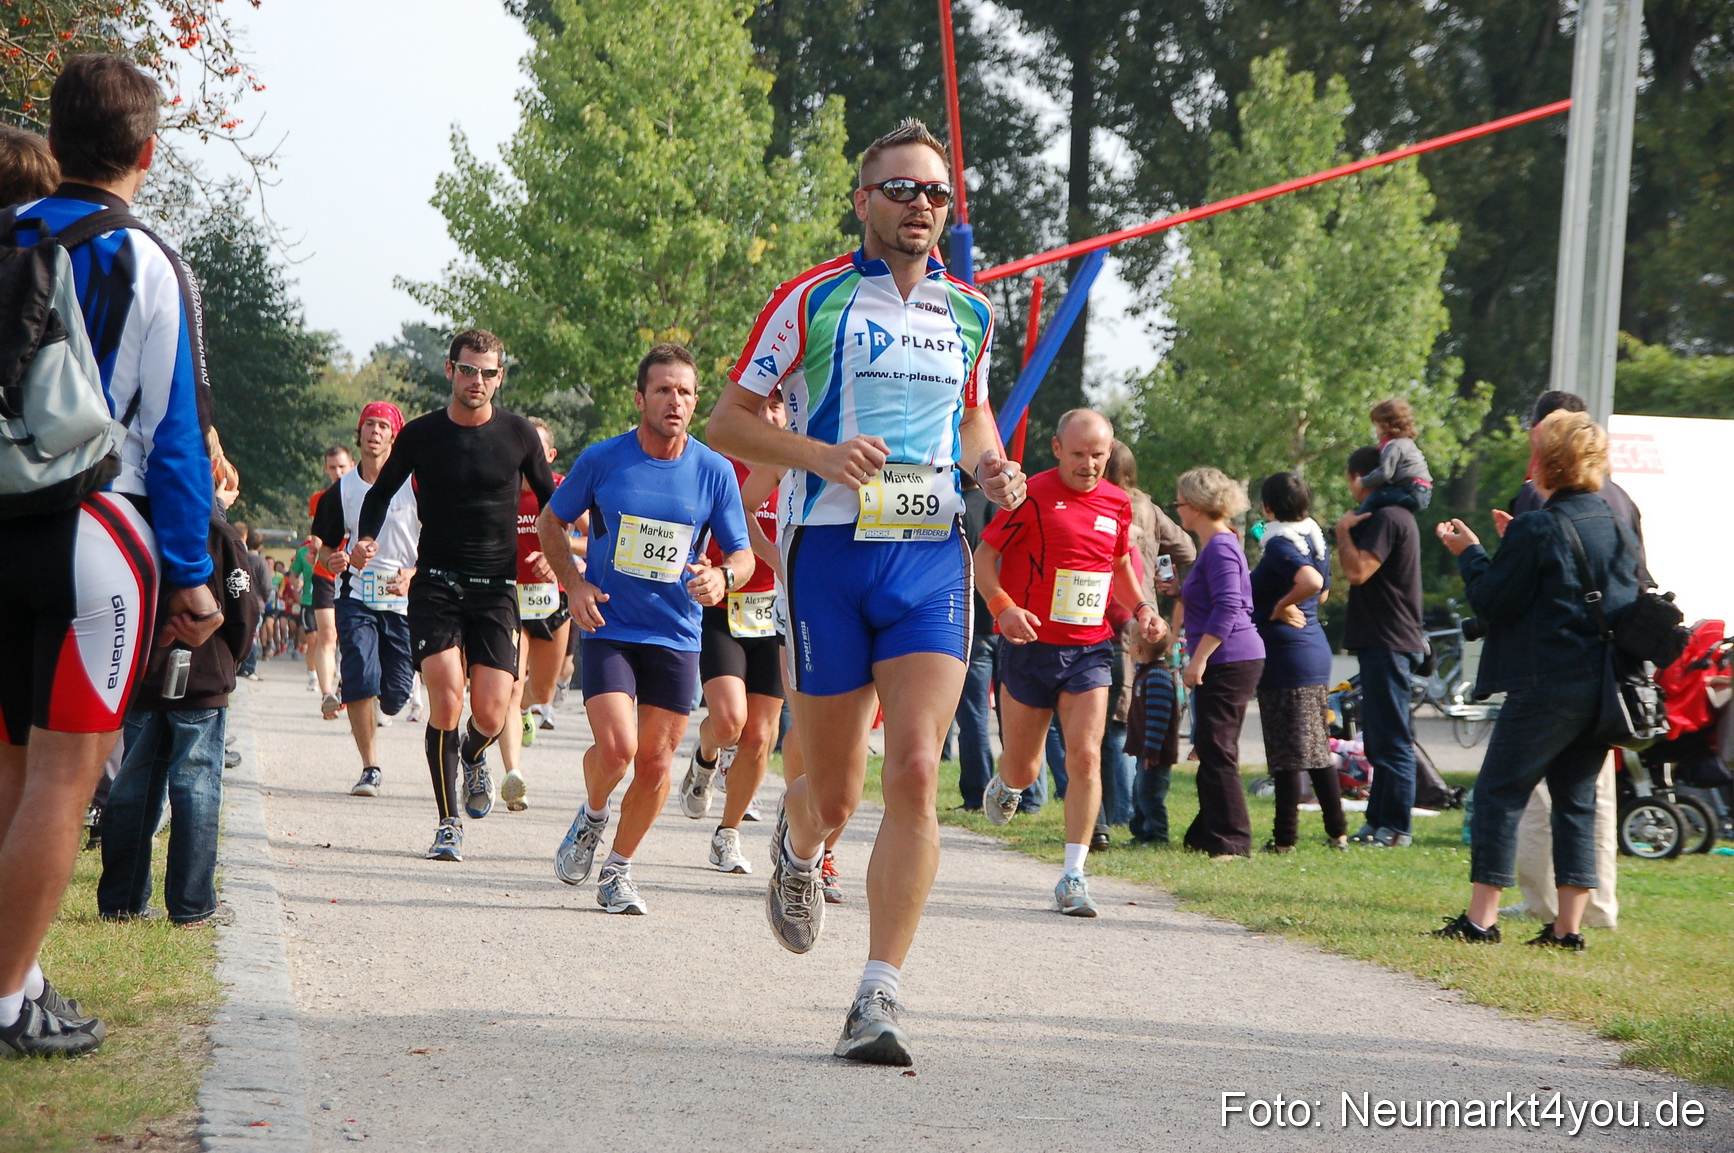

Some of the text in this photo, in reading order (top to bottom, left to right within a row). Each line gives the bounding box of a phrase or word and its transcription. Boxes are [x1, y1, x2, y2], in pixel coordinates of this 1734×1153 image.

[771, 319, 795, 352] TEC
[901, 334, 955, 353] PLAST
[855, 371, 958, 386] www.tr-plast.de
[883, 470, 924, 484] Martin
[865, 492, 871, 503] A
[895, 493, 941, 516] 359
[640, 522, 675, 540] Markus
[643, 542, 678, 563] 842
[1073, 575, 1101, 587] Herbert
[528, 594, 551, 606] 530
[1077, 592, 1101, 608] 862
